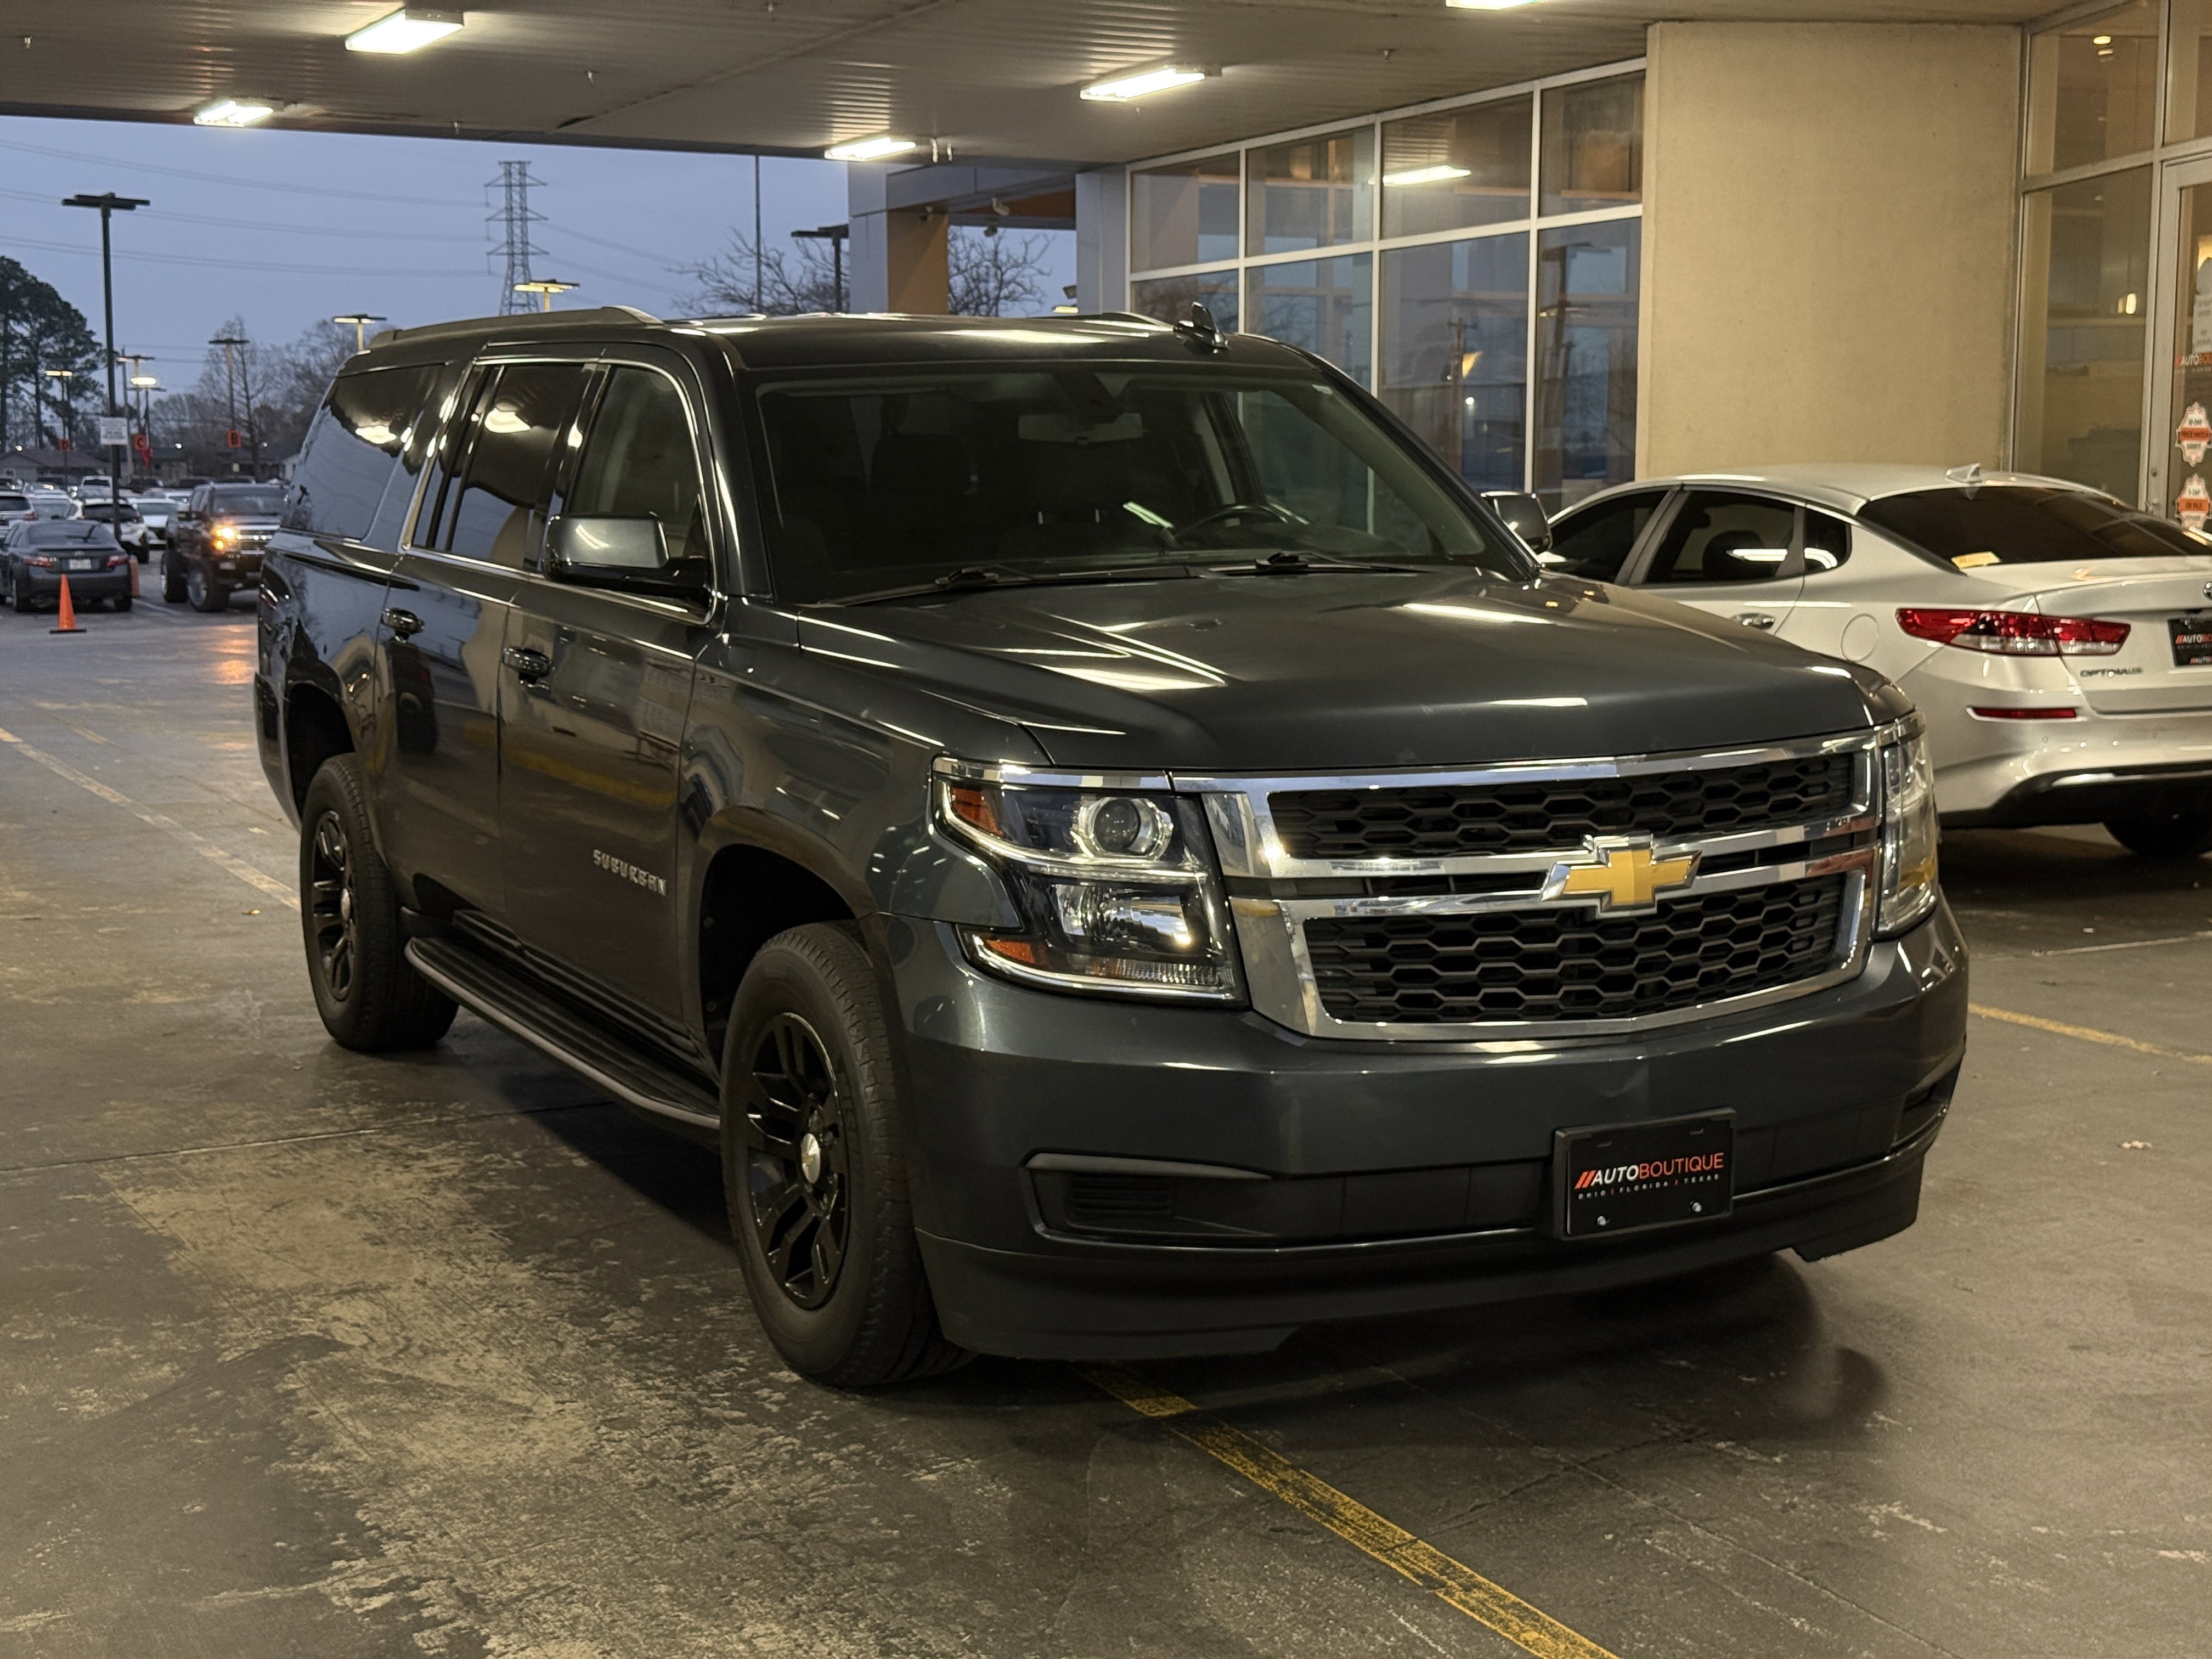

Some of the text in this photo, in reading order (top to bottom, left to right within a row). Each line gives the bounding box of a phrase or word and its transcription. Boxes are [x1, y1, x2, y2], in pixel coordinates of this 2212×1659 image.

[593, 849, 667, 896] SUBURBAN
[1591, 1152, 1725, 1186] AUTOBOUTIQUE
[1578, 1173, 1719, 1200] OHIO FLORIDA TEXAS
